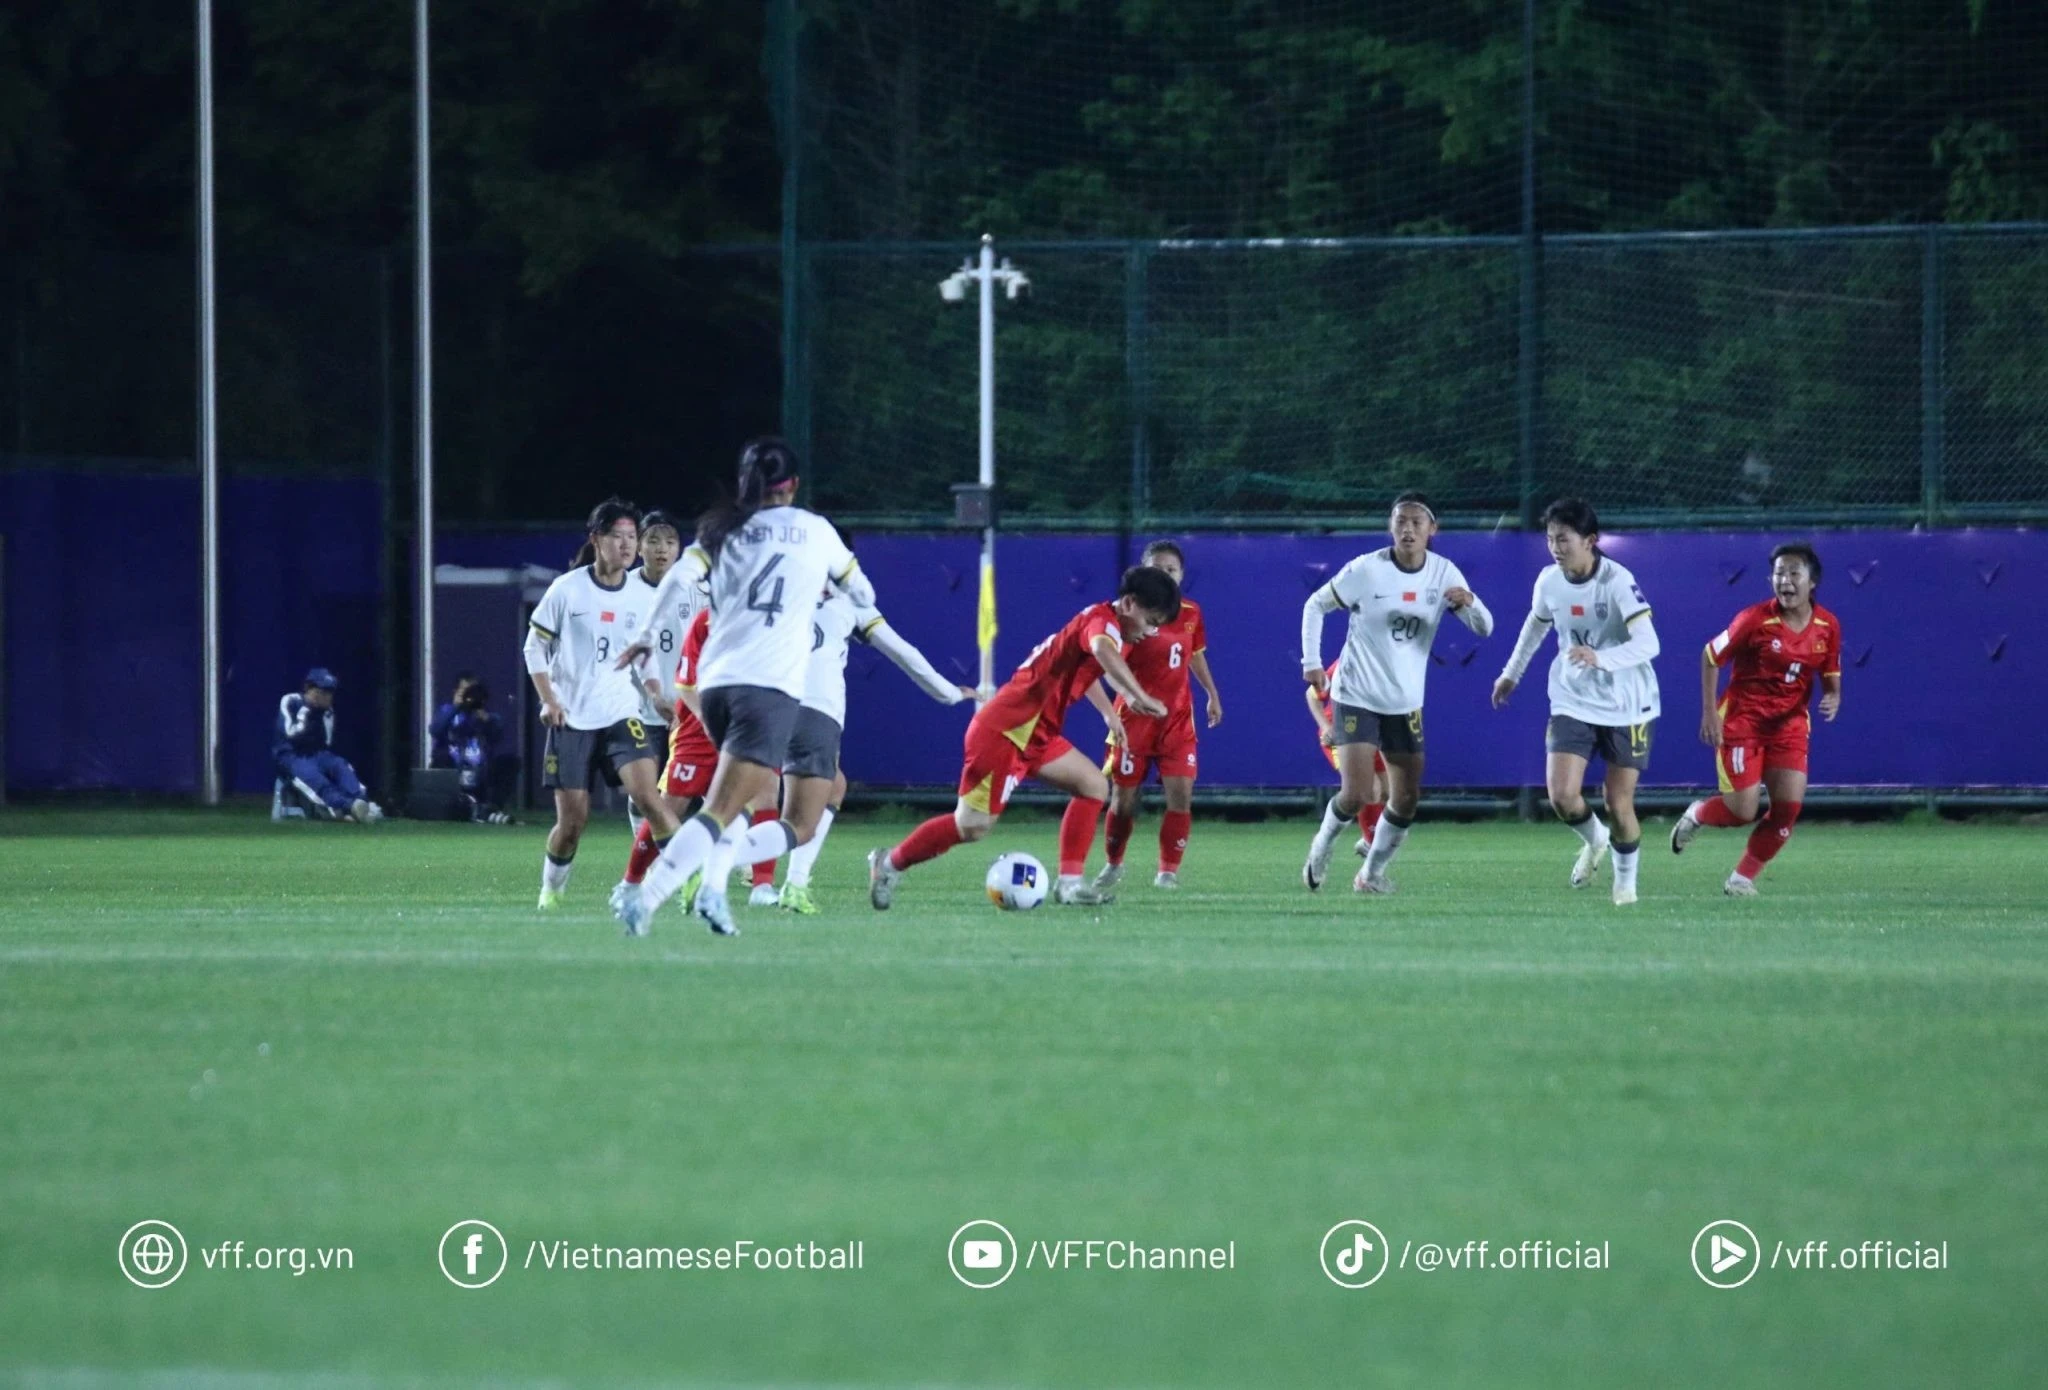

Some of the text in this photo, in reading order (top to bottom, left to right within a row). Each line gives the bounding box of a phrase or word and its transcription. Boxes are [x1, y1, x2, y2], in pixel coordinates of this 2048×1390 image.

[747, 552, 785, 628] 4
[659, 629, 674, 653] 8
[1391, 615, 1421, 642] 20
[1168, 642, 1182, 669] 6
[626, 717, 645, 740] 8
[1120, 751, 1134, 775] 6
[1731, 746, 1746, 774] 11
